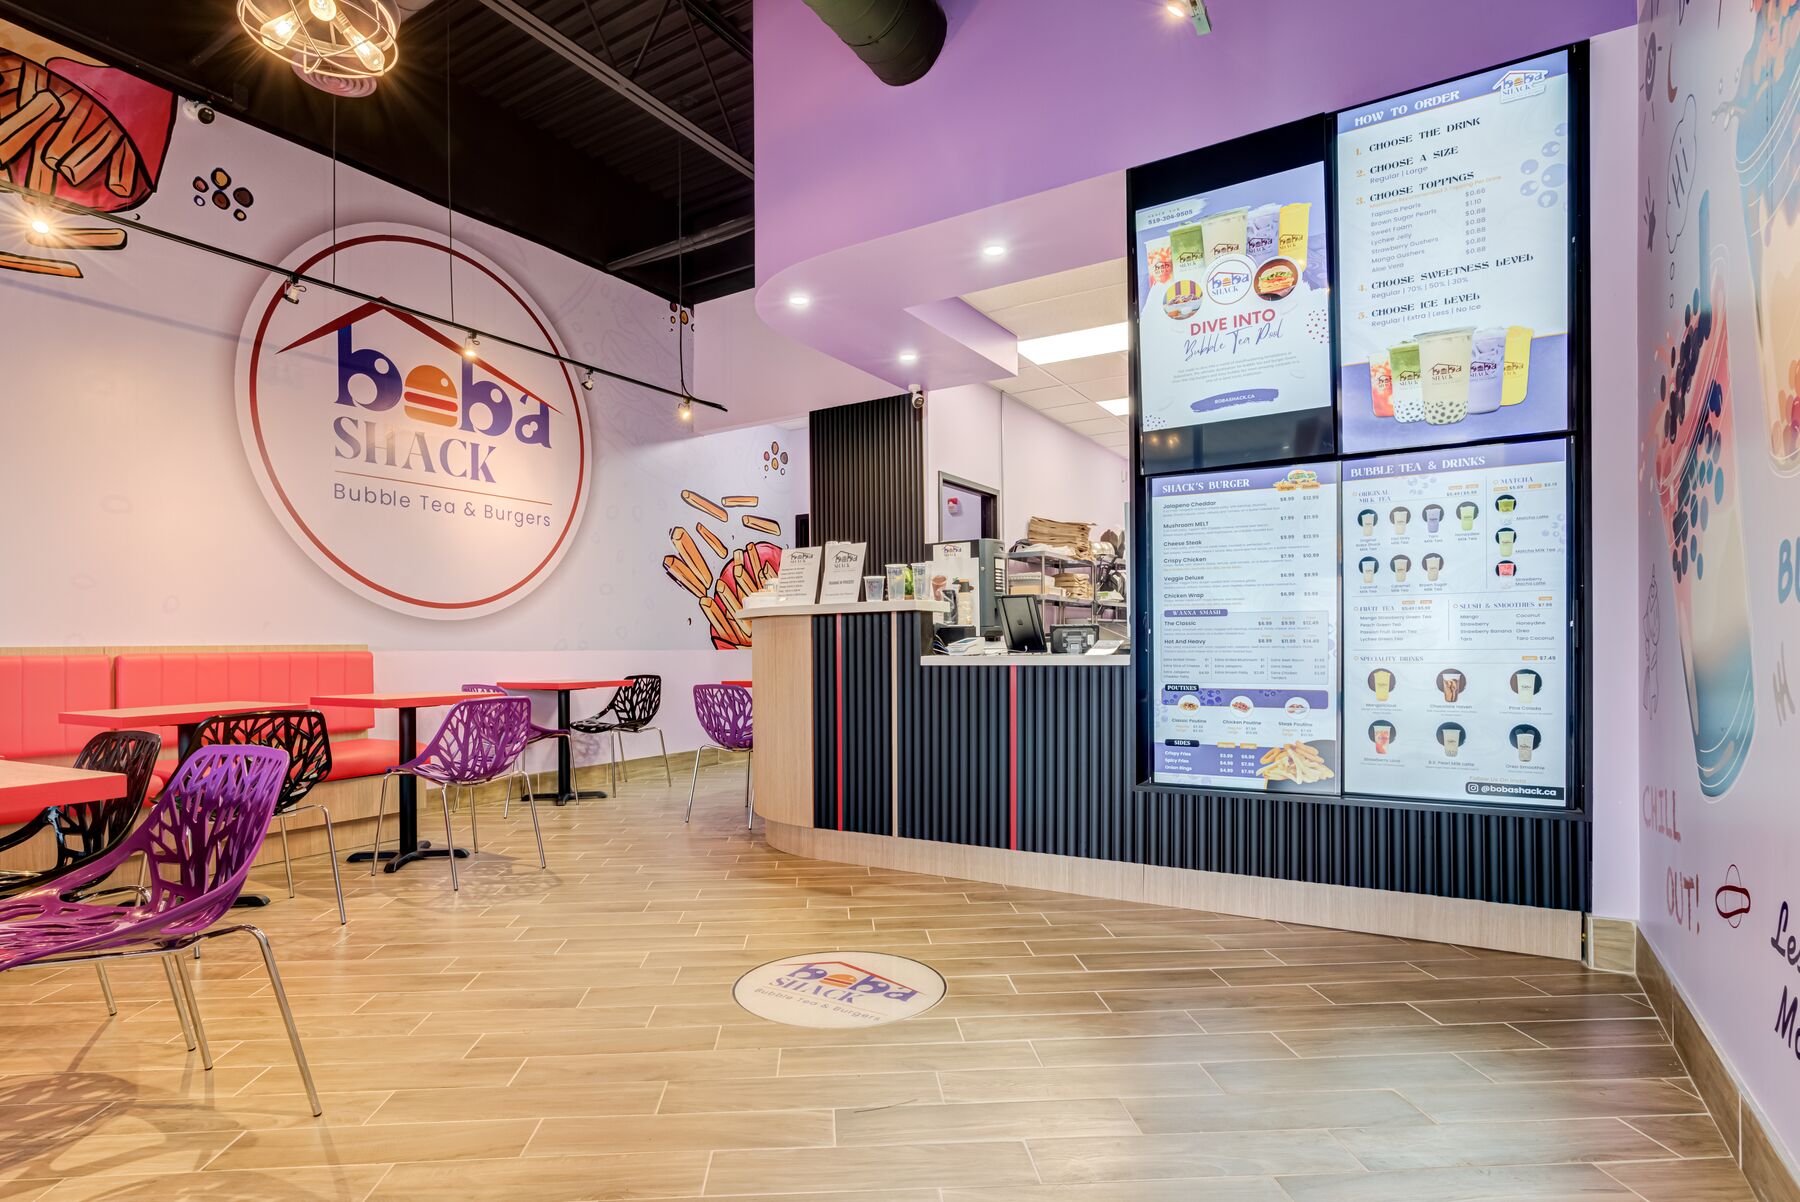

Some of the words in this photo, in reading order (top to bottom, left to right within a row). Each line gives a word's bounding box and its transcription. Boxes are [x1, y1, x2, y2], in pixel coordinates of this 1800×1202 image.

[1355, 111, 1384, 127] HOW
[1391, 105, 1408, 117] TO
[1415, 90, 1460, 110] ORDER
[1369, 134, 1413, 152] CHOOSE
[1419, 127, 1441, 140] THE
[1447, 117, 1481, 133] DRINK
[1370, 157, 1414, 175] CHOOSE
[1419, 154, 1427, 162] A
[1433, 146, 1459, 159] SIZE
[1672, 137, 1689, 209] Hi
[1370, 173, 1400, 184] Regular
[1405, 165, 1428, 176] Large
[1370, 186, 1414, 202] CHOOSE
[1419, 171, 1475, 191] TOPPINGS
[1371, 207, 1398, 218] Tapioca
[1400, 202, 1421, 212] Pearls
[1371, 218, 1392, 227] Brown
[1394, 214, 1414, 224] Sugar
[1415, 208, 1437, 218] Pearls
[1465, 198, 1482, 207] $1.10
[1371, 228, 1391, 236] Sweet
[1392, 223, 1413, 232] Foam
[1371, 235, 1395, 246] Lychee
[1396, 232, 1412, 242] Jelly
[1371, 243, 1408, 255] Strawberry
[1409, 236, 1439, 247] Gushers
[1371, 255, 1395, 264] Mango
[1396, 248, 1425, 259] Gushers
[1371, 265, 1388, 273] Aloe
[1388, 262, 1404, 270] Vera
[1371, 275, 1415, 290] CHOOSE
[1420, 261, 1489, 281] SWEETNESS
[1495, 253, 1534, 267] LEVEL
[1371, 289, 1400, 300] Regular
[1407, 285, 1422, 293] 70%
[1429, 281, 1445, 290] 50%
[1452, 276, 1469, 285] 30%
[1371, 303, 1415, 318] CHOOSE
[1420, 299, 1439, 309] ICE
[1444, 292, 1480, 306] LEVEL
[1371, 317, 1400, 327] Regular
[1407, 313, 1426, 321] Extra
[1432, 309, 1449, 317] Less
[1456, 304, 1467, 313] No
[1468, 303, 1481, 311] Ice
[1190, 317, 1227, 336] DIVE
[1233, 308, 1276, 329] INTO
[1184, 338, 1226, 361] Bubble
[1225, 327, 1250, 354] Tea
[1214, 394, 1256, 404] BOBASHACK.CA
[333, 416, 496, 484] SHACK
[1350, 465, 1394, 477] BUBBLE
[1399, 463, 1422, 473] TEA
[1428, 460, 1437, 470] &
[1442, 456, 1486, 469] DRINKS
[1500, 476, 1534, 484] MATCHA
[1162, 482, 1204, 494] SHACK'S
[1208, 478, 1250, 490] BURGER
[334, 483, 411, 508] Bubble
[419, 494, 456, 515] Tea
[464, 501, 477, 517] &
[484, 505, 551, 527] Burgers
[1480, 784, 1557, 797] @bobashack.ca
[1643, 785, 1681, 843] CHILL
[1667, 865, 1700, 935] OUT!
[769, 976, 865, 1004] SHACK
[754, 987, 794, 1000] Bubble
[797, 997, 818, 1006] Tea
[820, 1001, 830, 1009] &
[833, 1006, 881, 1022] Burgers
